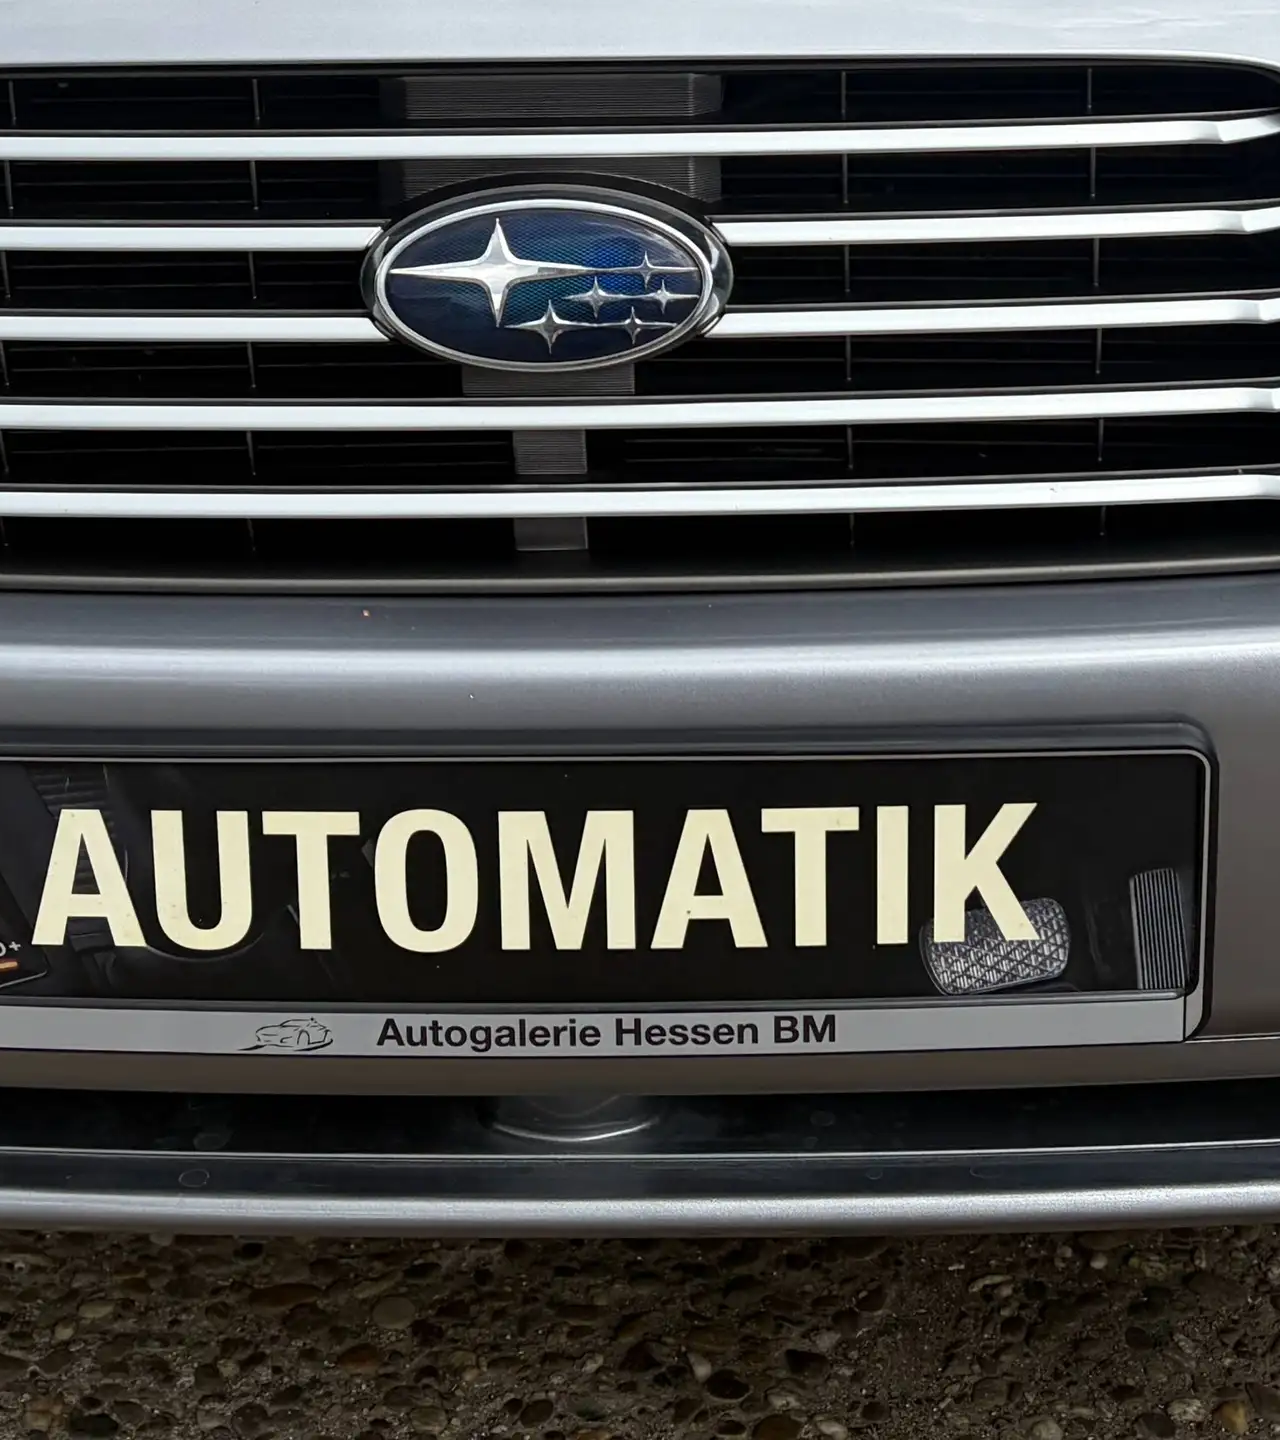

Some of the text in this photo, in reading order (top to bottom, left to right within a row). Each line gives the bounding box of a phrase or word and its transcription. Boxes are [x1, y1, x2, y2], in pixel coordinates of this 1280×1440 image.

[33, 803, 1039, 954] AUTOMATIK
[376, 1014, 836, 1053] Autogalerie Hessen BM
